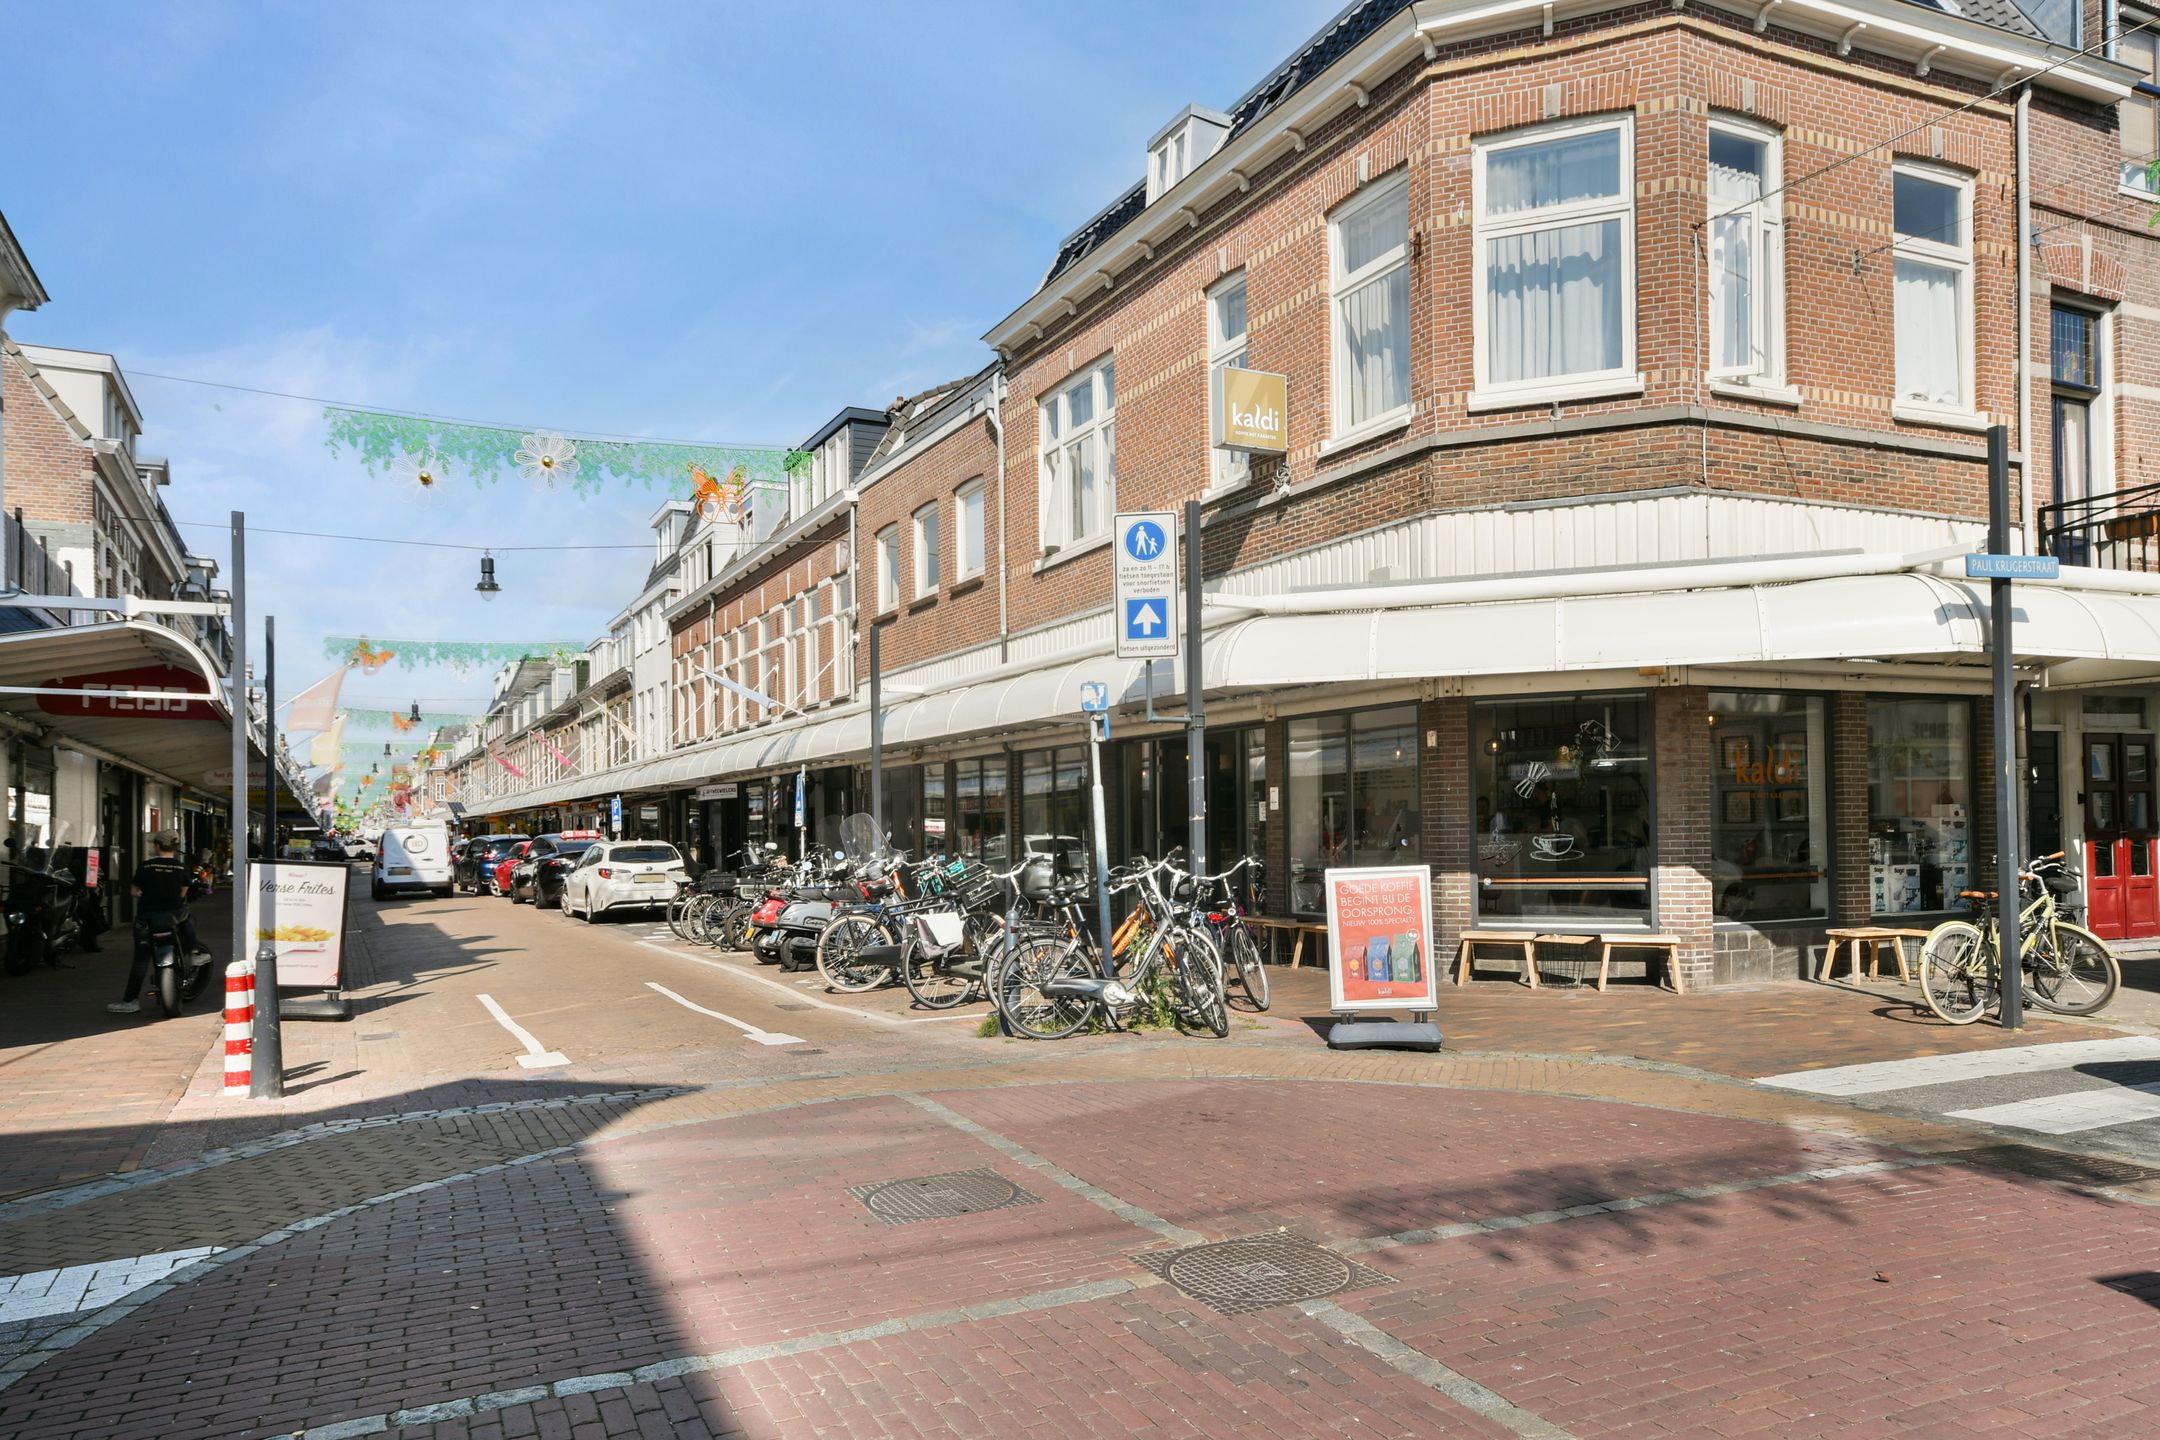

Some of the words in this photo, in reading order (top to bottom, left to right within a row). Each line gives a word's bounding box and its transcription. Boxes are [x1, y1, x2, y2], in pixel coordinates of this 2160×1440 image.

[1232, 402, 1279, 431] kaldi
[1972, 560, 1993, 572] PAUL
[1995, 560, 2056, 573] KRUGERSTRAAT
[1140, 644, 1175, 653] uitgezonderd
[82, 683, 188, 711] FEBO
[1735, 744, 1800, 785] kaldi
[259, 879, 295, 893] Verse
[298, 881, 336, 895] Frites
[1340, 883, 1377, 895] GOEDE
[1380, 880, 1415, 892] KOFFIE
[1340, 895, 1379, 906] BEGINT
[1398, 893, 1411, 903] DE
[1342, 904, 1415, 918] OORSPRONG.
[1368, 918, 1383, 926] 100%
[1385, 917, 1416, 925] SPECIALTY
